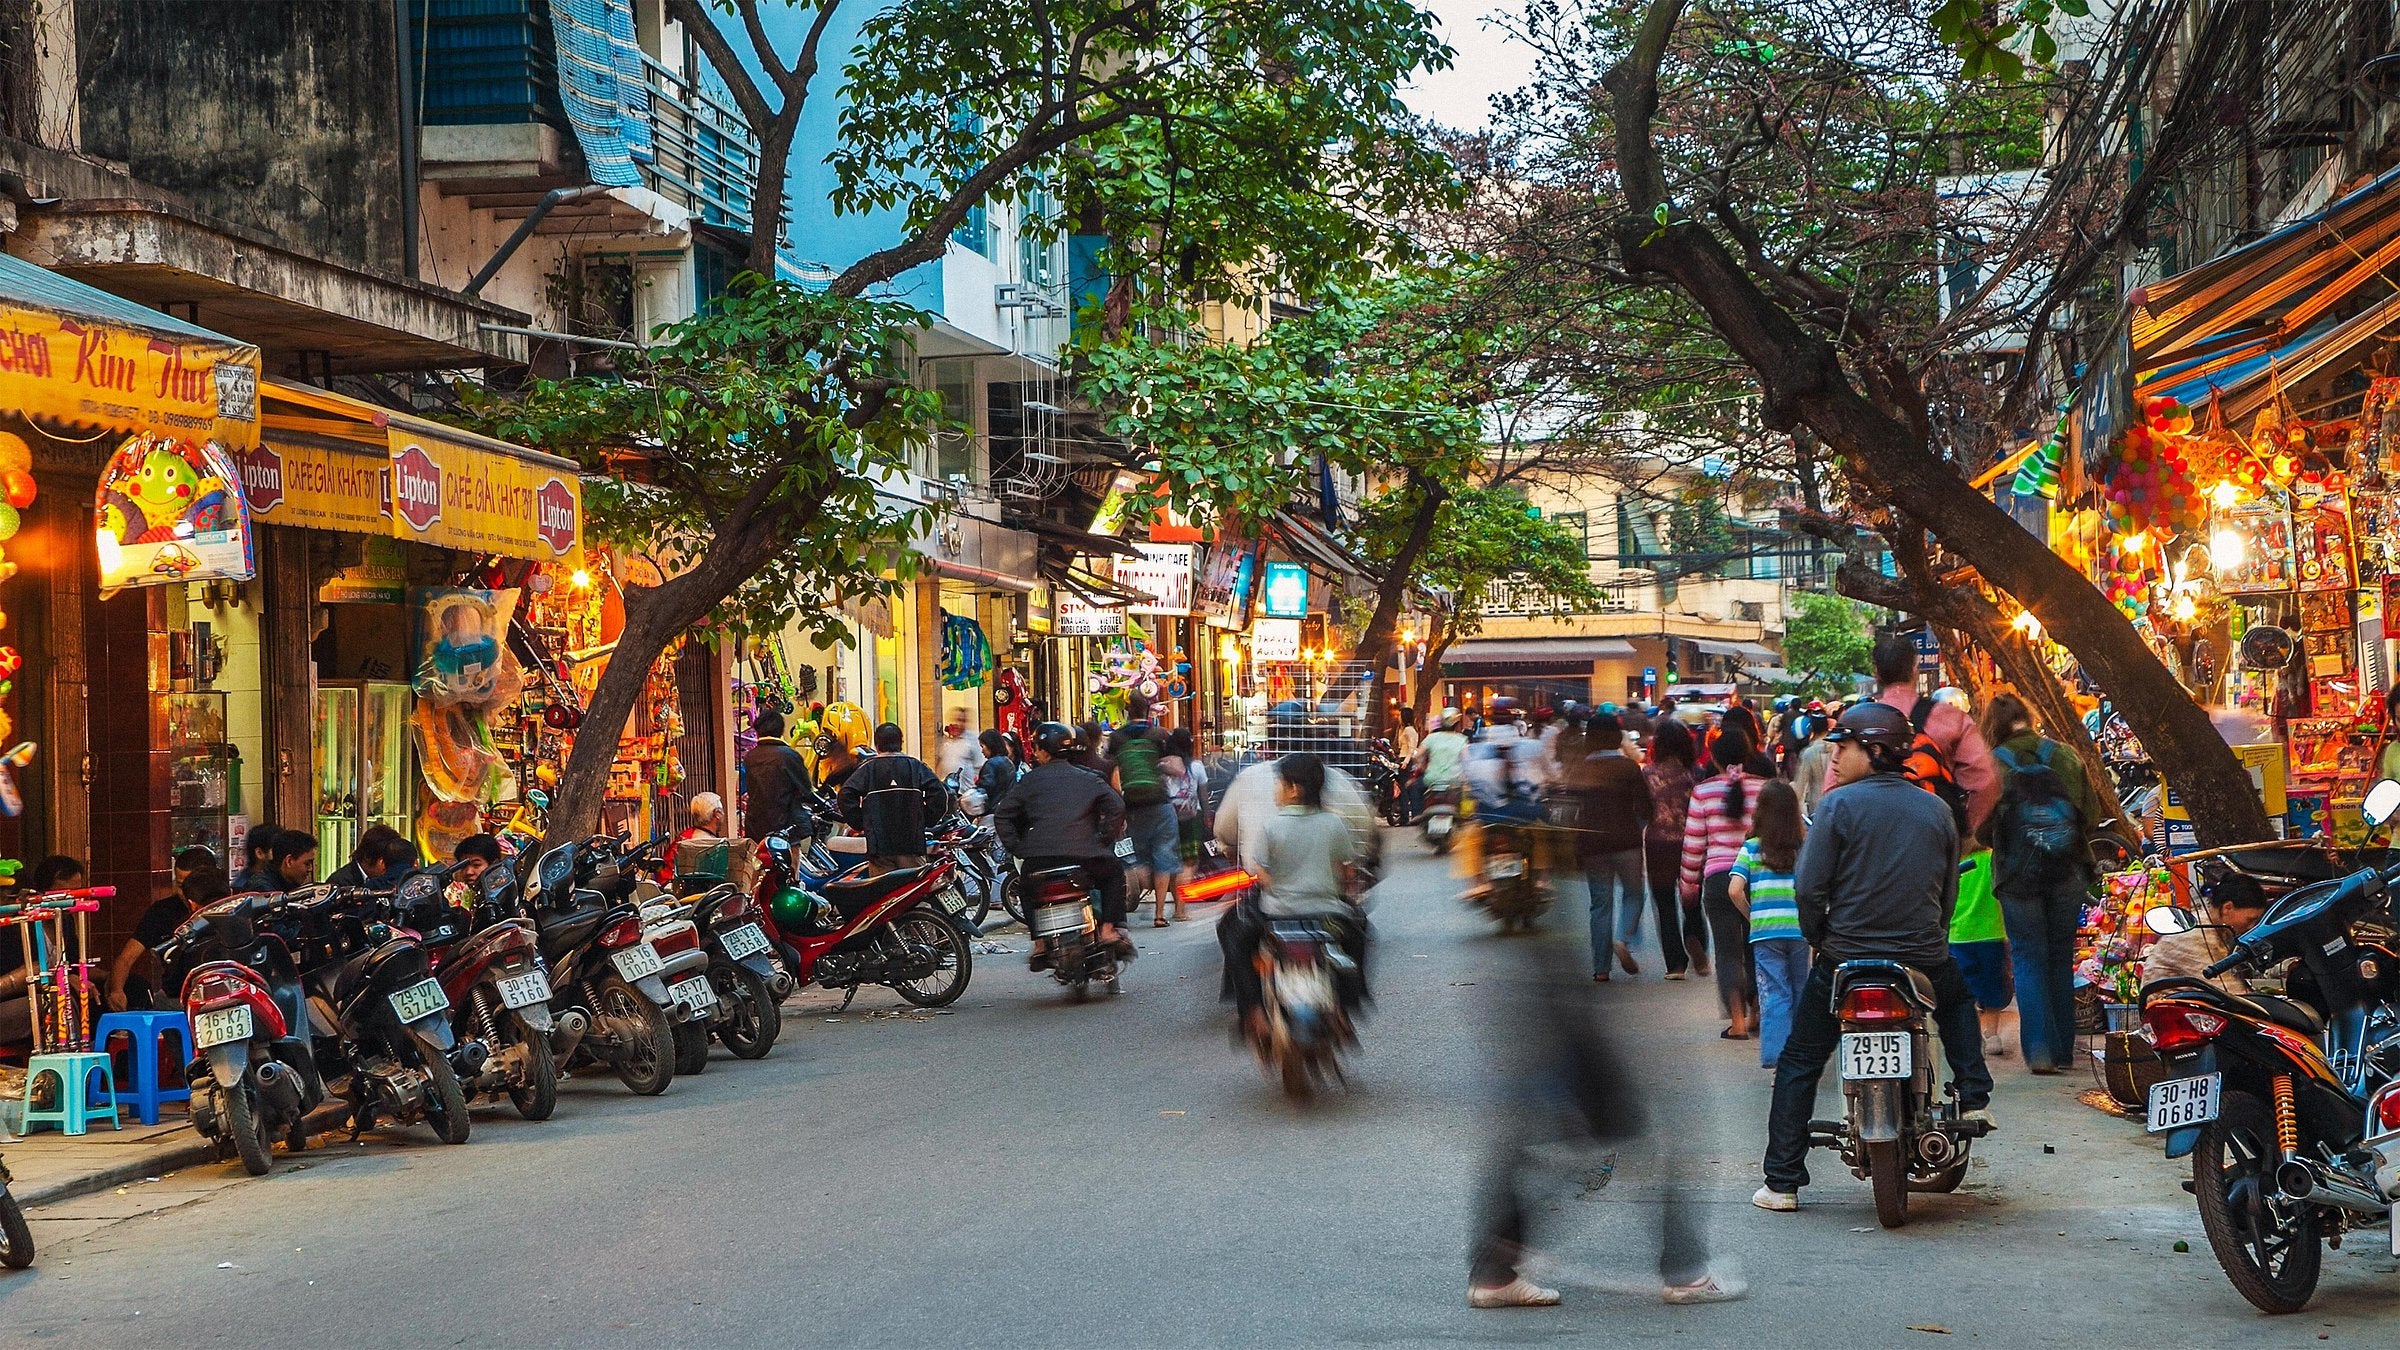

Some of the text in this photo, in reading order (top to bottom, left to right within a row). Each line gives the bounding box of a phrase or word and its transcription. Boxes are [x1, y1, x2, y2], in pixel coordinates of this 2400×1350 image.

[59, 319, 136, 393] Kim
[288, 451, 313, 491] CAFÉ
[364, 470, 375, 499] 37
[395, 463, 437, 511] Lipton
[446, 464, 472, 510] CAFÉ
[522, 487, 532, 521] 37
[541, 495, 573, 537] Lipton
[1168, 554, 1188, 566] CAFE
[1061, 603, 1086, 614] SIM
[1060, 625, 1090, 634] MOBI CARD
[2332, 803, 2357, 811] tchen
[619, 946, 651, 966] 29-Y6
[733, 937, 763, 956] 5358
[627, 958, 658, 978] 1029
[505, 975, 539, 992] 30-F4
[675, 978, 703, 998] 29-Y7
[397, 983, 432, 1006] 29-U7
[510, 987, 544, 1005] 5160
[688, 991, 709, 1007] 107
[404, 995, 440, 1017] 3744
[206, 1023, 244, 1044] 2093
[1853, 1035, 1900, 1055] 29-U5
[1854, 1056, 1900, 1075] 1233
[2175, 1051, 2198, 1060] HONDA
[2159, 1078, 2209, 1106] 30-H8
[2158, 1099, 2207, 1127] 0683
